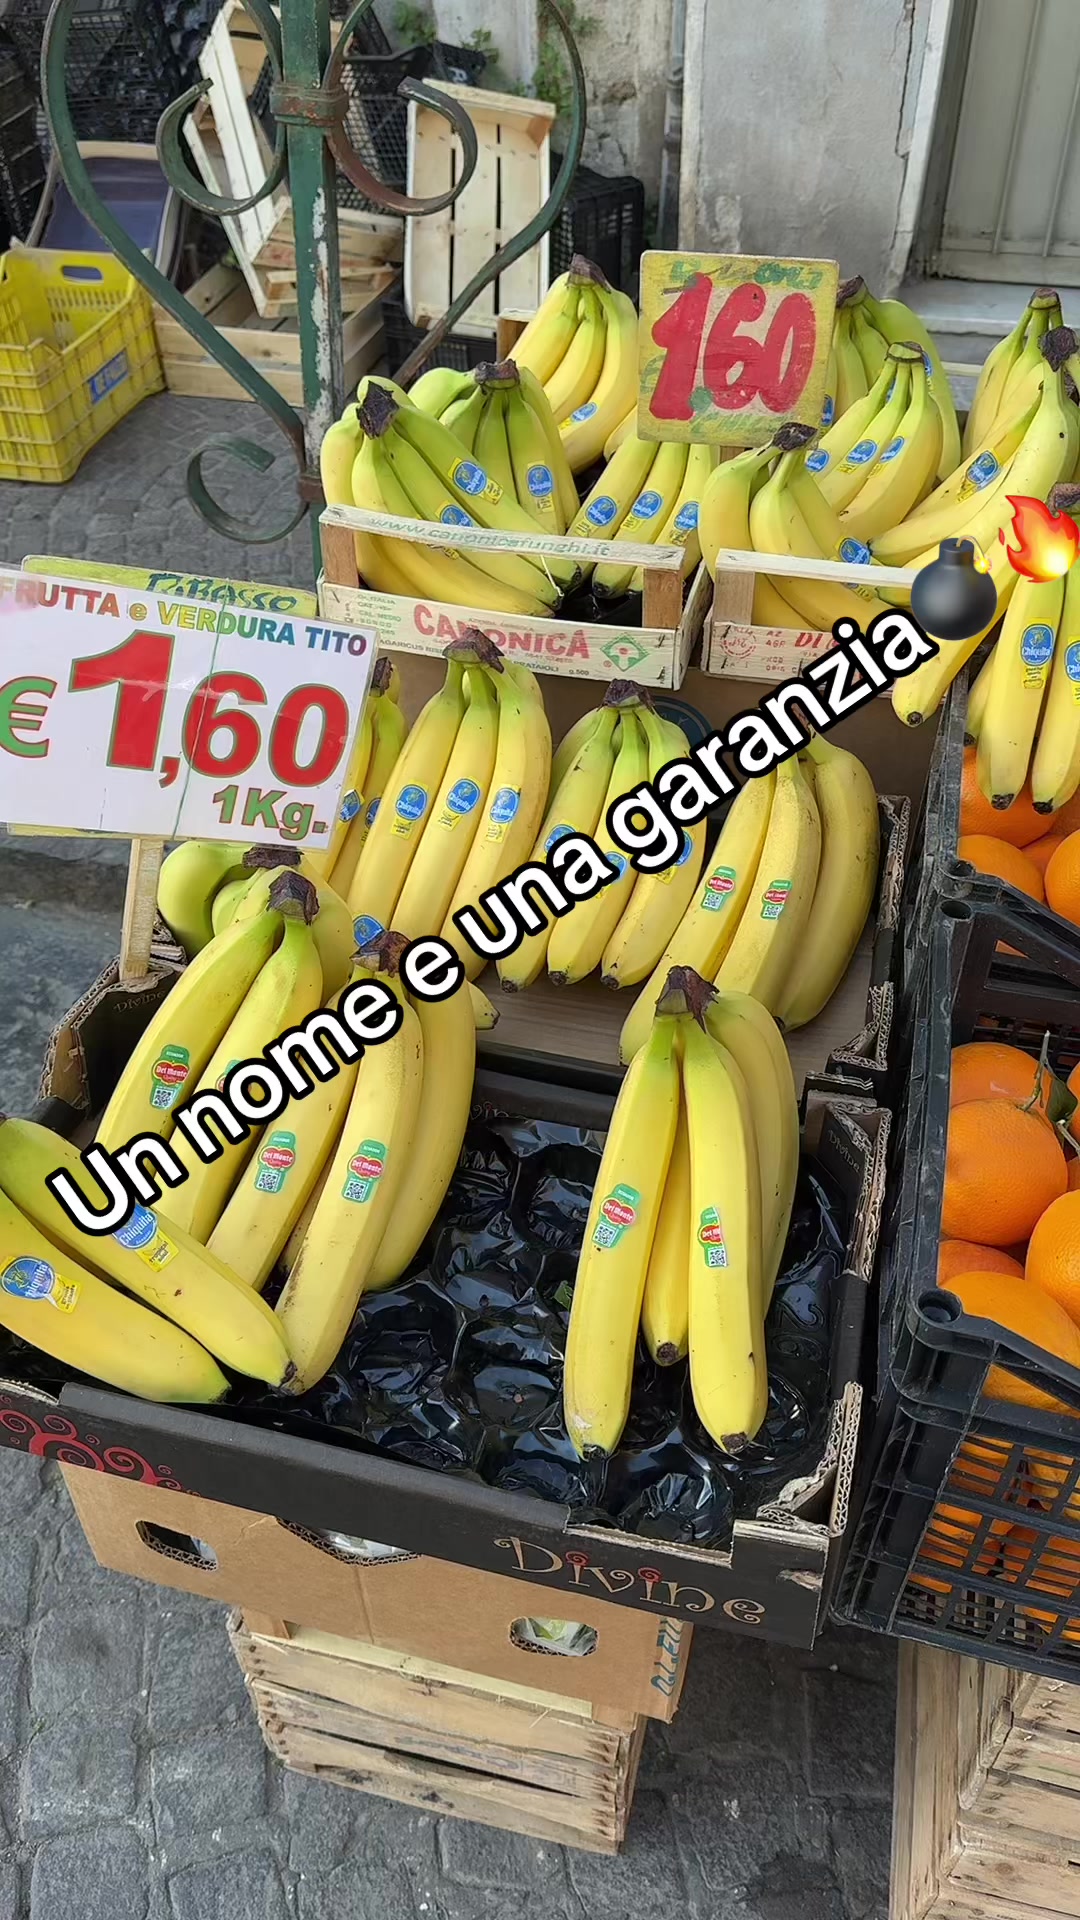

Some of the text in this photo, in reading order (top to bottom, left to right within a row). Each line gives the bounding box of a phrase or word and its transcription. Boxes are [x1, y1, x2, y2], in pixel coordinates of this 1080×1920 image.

[129, 602, 148, 621] e
[157, 600, 297, 647] VERDURA
[304, 625, 368, 657] TITO
[0, 628, 351, 789] € 1,60
[118, 1213, 154, 1246] Chiquita
[493, 1536, 766, 1625] Divine
